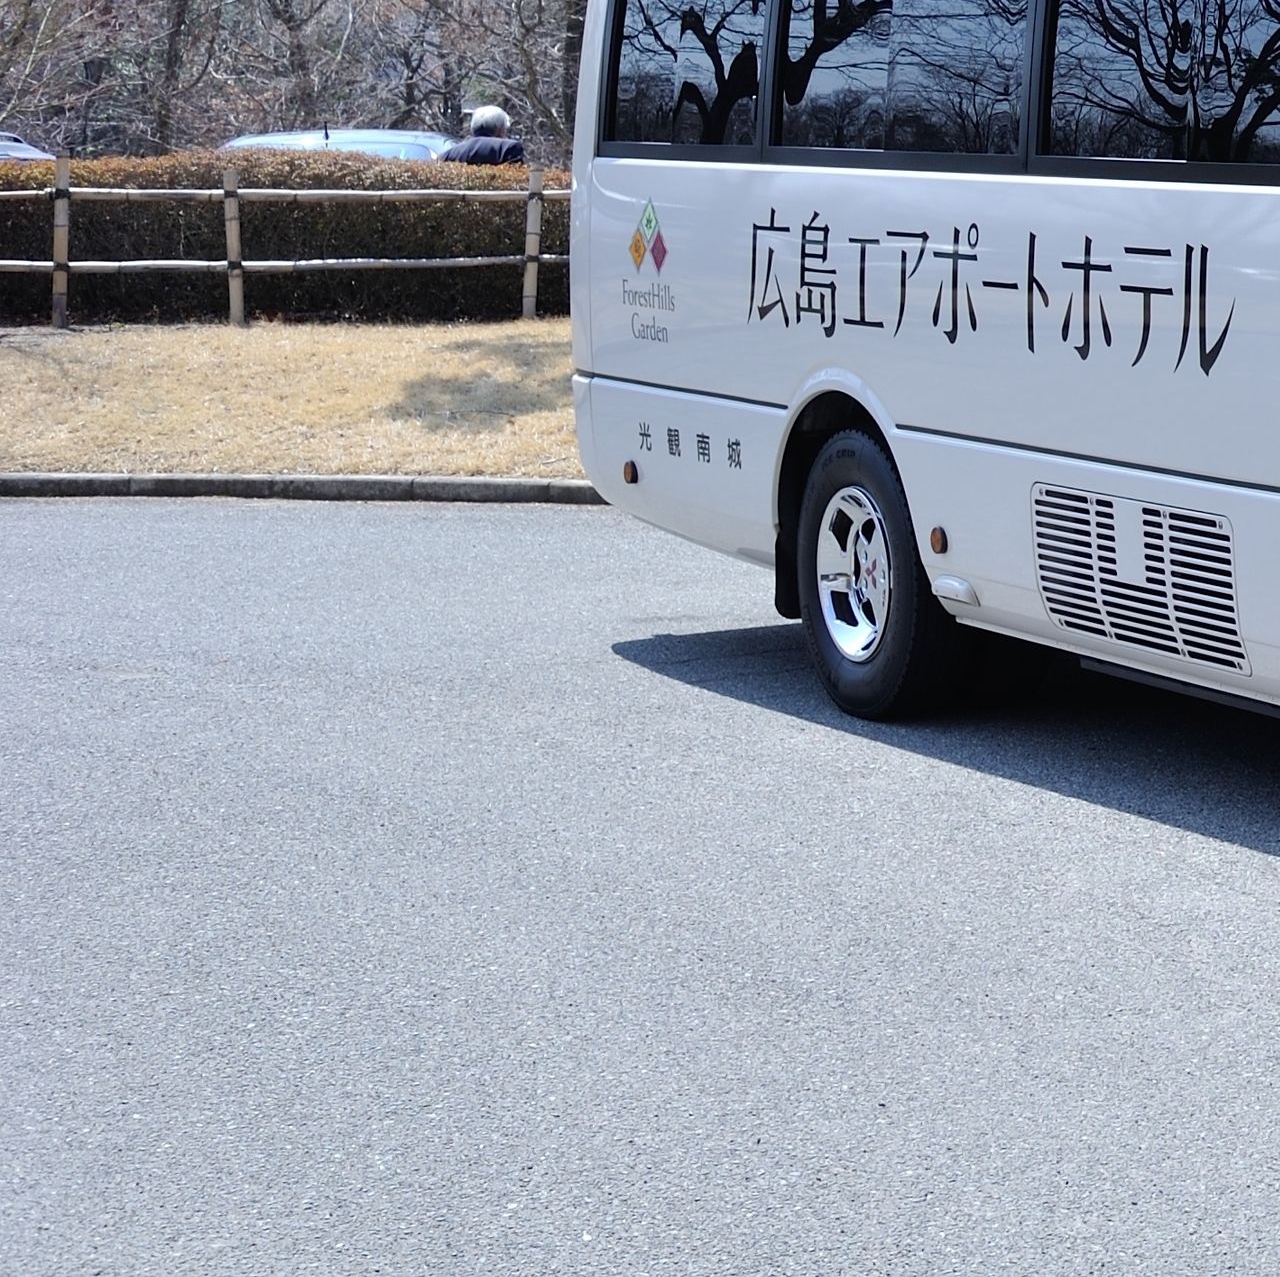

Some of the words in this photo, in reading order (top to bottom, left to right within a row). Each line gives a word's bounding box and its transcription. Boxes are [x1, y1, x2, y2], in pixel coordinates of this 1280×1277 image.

[622, 278, 676, 312] ForestHills
[747, 206, 1236, 377] 広島エアポートホテル
[631, 312, 669, 343] Garden
